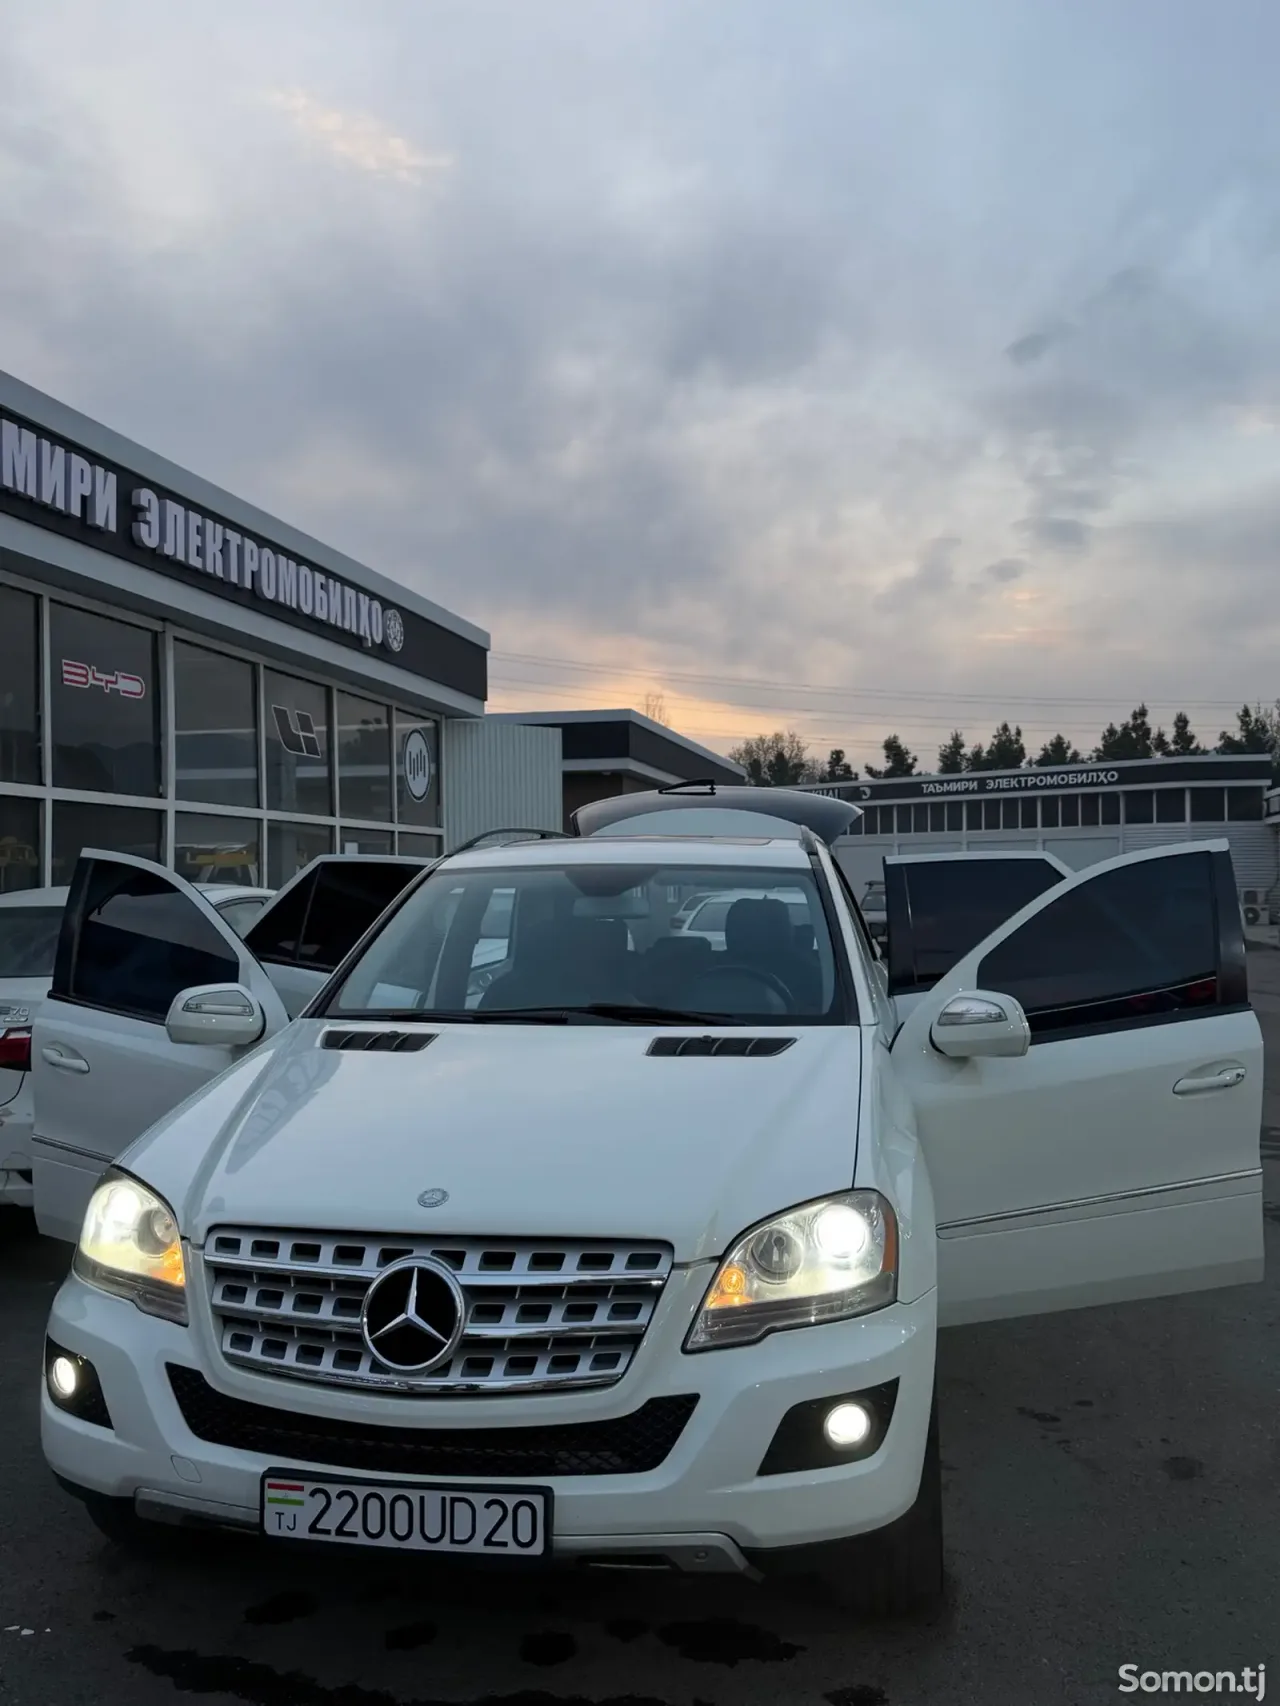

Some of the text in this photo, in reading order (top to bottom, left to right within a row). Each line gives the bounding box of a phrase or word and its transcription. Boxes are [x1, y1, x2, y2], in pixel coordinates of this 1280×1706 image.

[1, 419, 117, 533] МИРИ
[62, 660, 145, 699] BYD
[922, 771, 1119, 793] ТАЪМИРИ ЭЛЕКТРОМОБИЛҲО
[275, 1512, 297, 1532] TJ
[308, 1487, 538, 1549] 2200UD20
